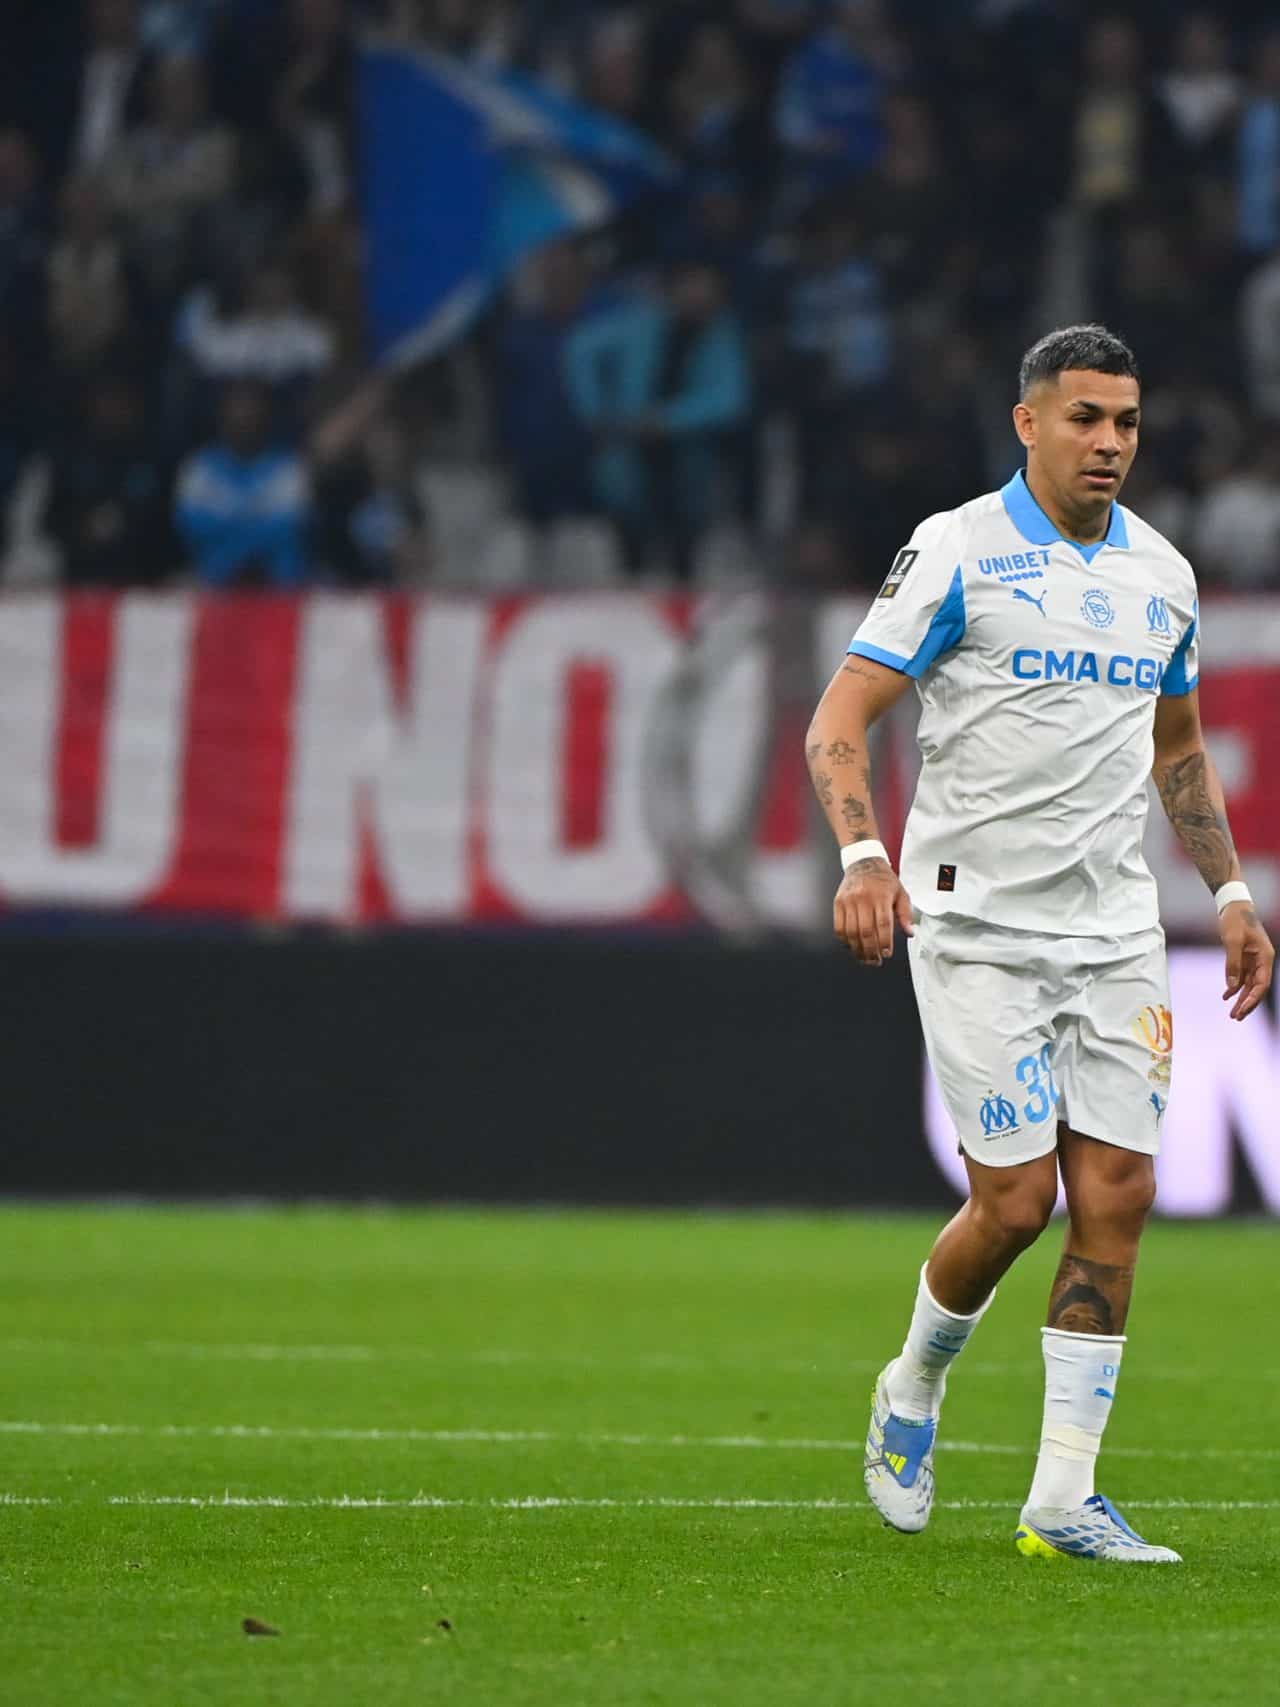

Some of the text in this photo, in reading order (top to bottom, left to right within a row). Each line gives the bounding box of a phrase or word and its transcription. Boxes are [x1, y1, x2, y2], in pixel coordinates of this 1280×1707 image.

[978, 550, 1051, 575] UNIBET
[1012, 649, 1163, 690] CMA CG
